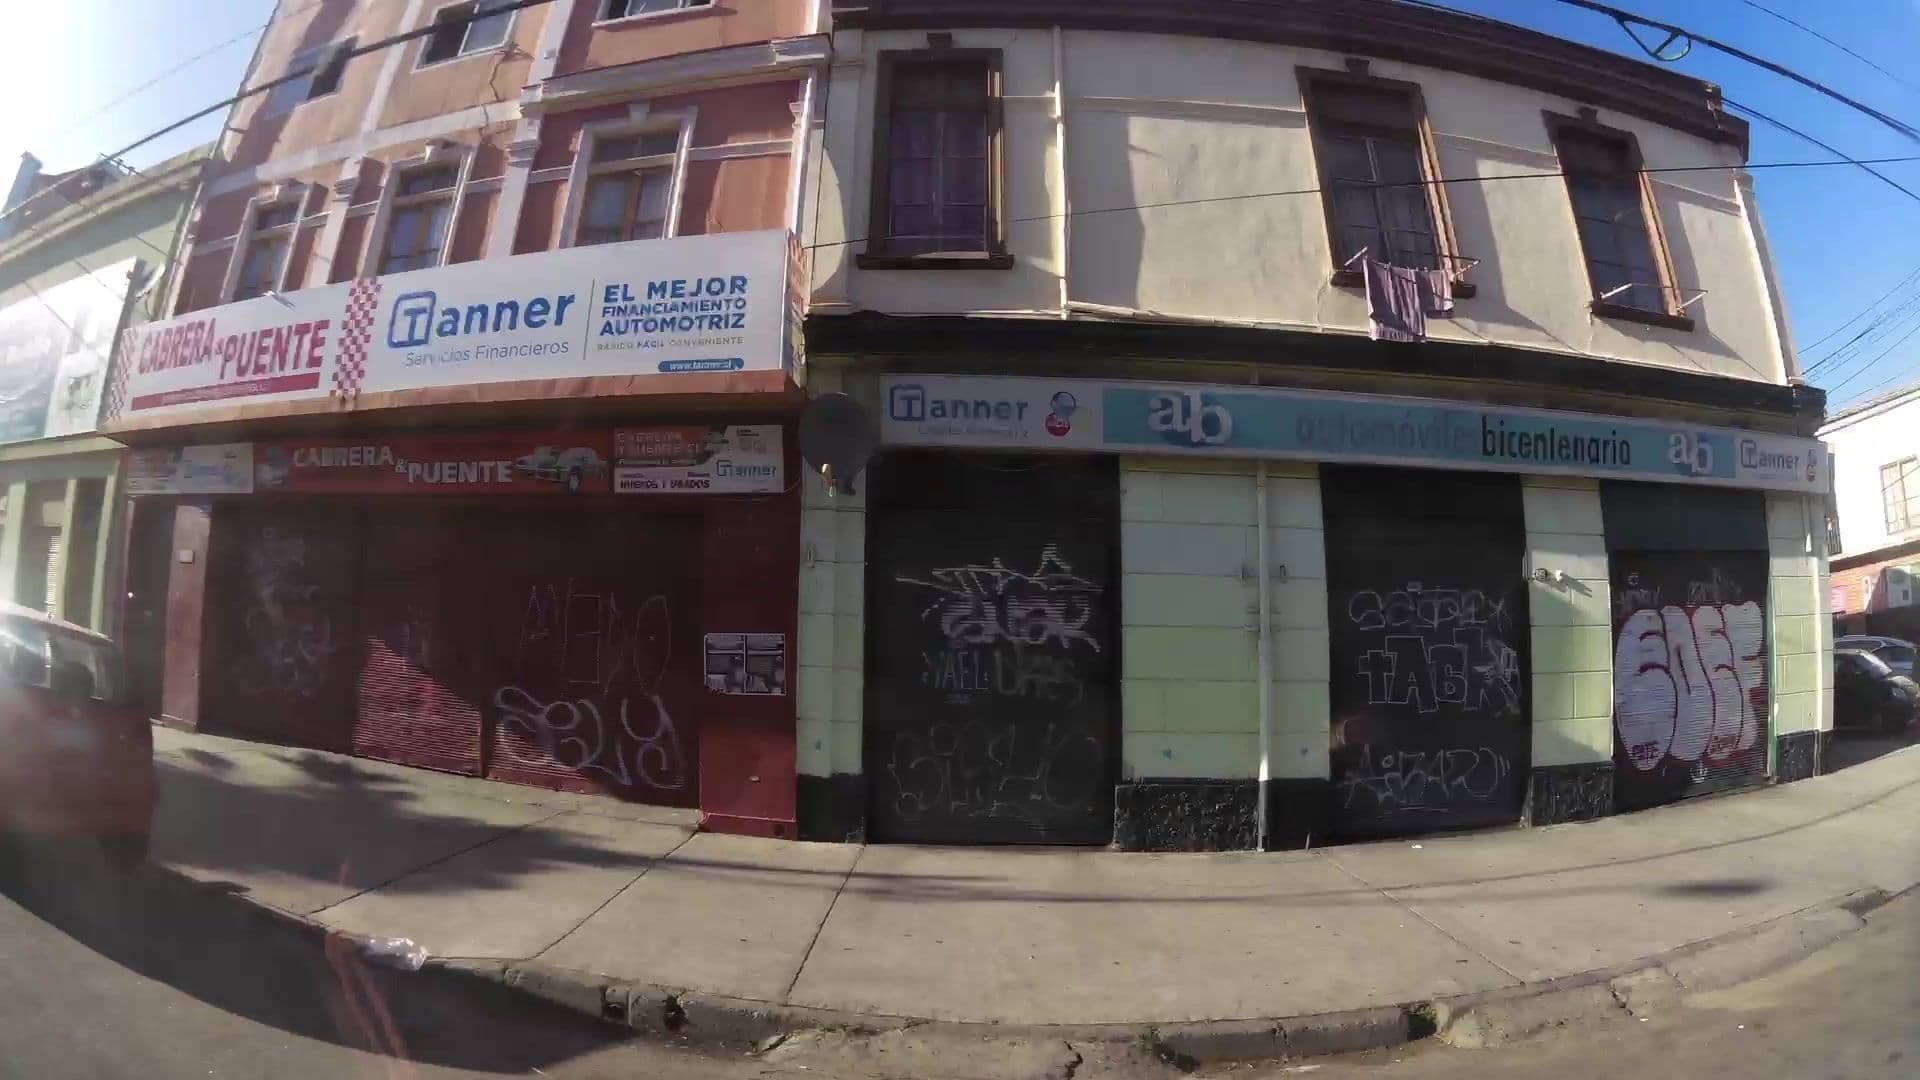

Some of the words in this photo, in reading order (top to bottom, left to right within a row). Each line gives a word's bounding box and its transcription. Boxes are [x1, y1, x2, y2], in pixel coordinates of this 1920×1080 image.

[604, 283, 635, 303] EL
[647, 275, 748, 300] MEJOR
[387, 290, 575, 348] Tanner
[602, 297, 747, 318] FINANCIAMIENTO
[600, 312, 746, 337] AUTOMOTRIZ
[138, 317, 217, 375] CABRERA
[219, 318, 331, 380] PUENTE
[475, 341, 569, 360] Financieros
[889, 384, 1028, 422] Tanner
[293, 445, 394, 467] CABRERA
[407, 460, 513, 483] PUENTE
